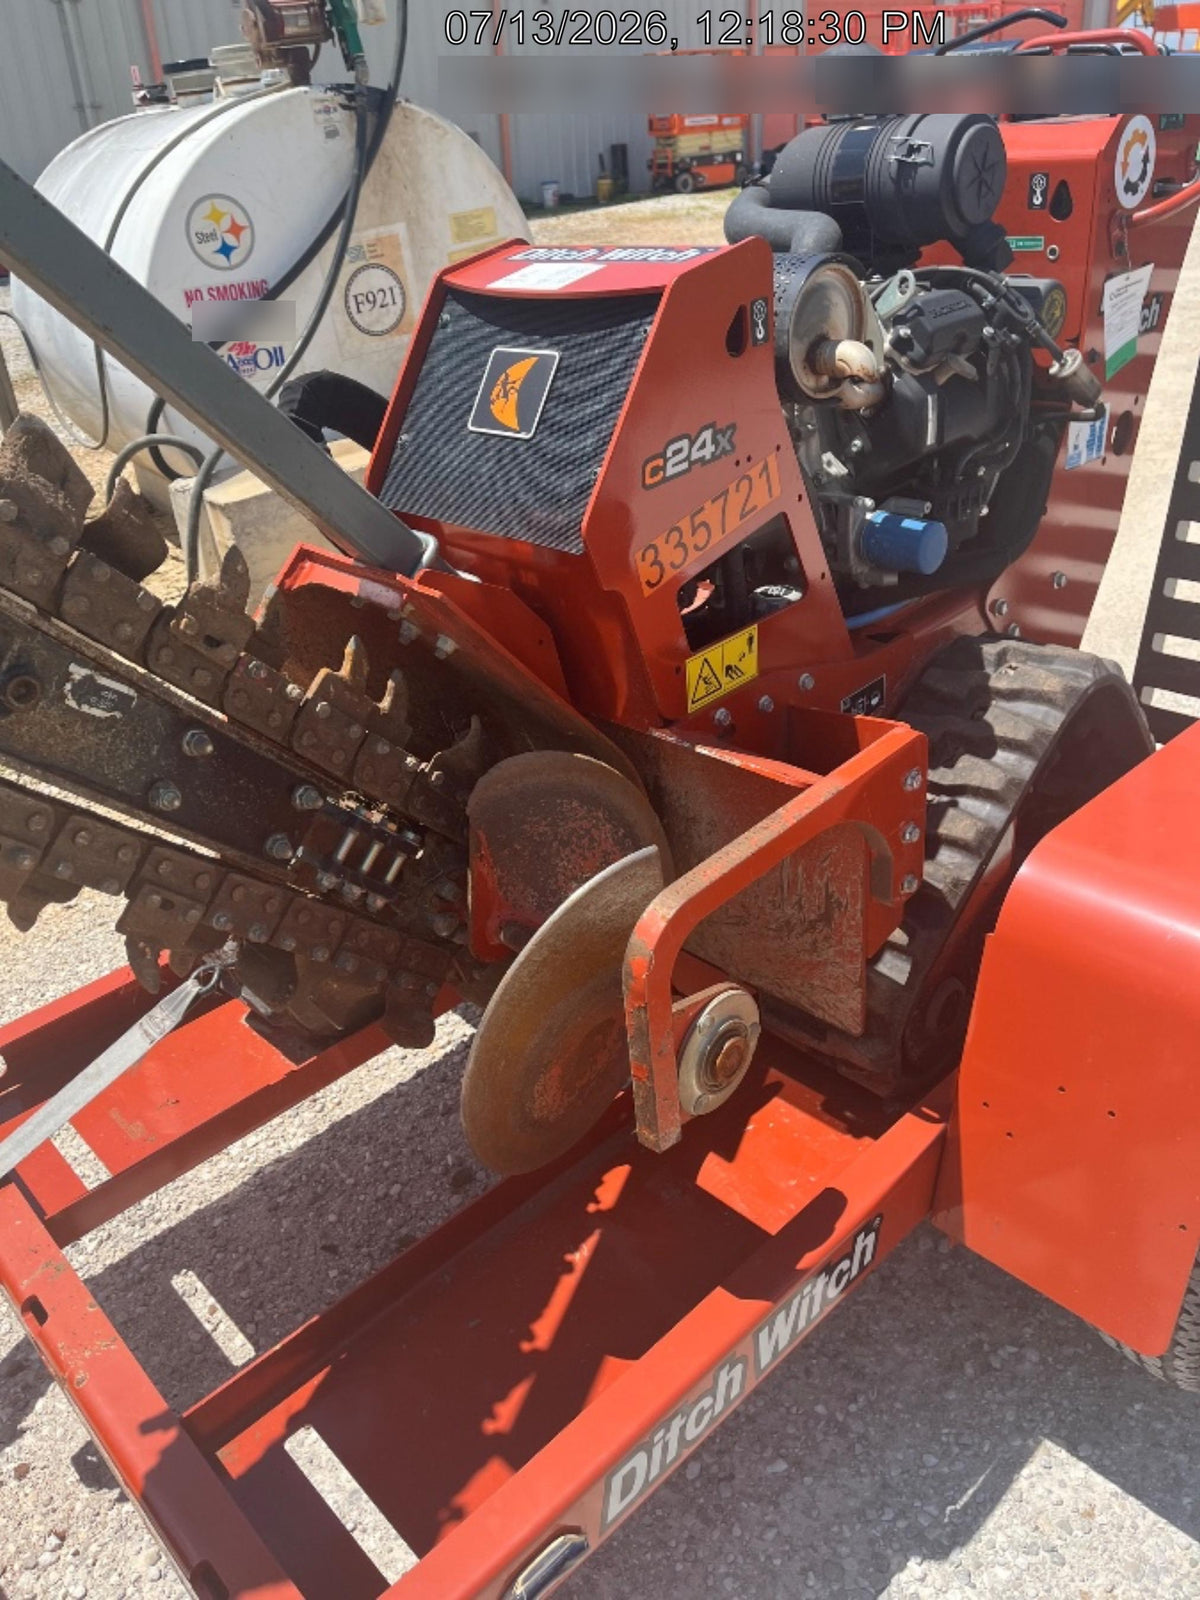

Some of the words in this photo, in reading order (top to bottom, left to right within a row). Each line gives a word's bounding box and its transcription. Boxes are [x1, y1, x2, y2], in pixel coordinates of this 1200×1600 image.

[195, 228, 218, 245] Steel
[184, 288, 203, 309] NO
[207, 279, 269, 301] SMOKING
[352, 286, 398, 314] F921
[641, 458, 774, 589] 335721
[606, 1362, 744, 1524] Ditch
[757, 1229, 878, 1371] Witch
